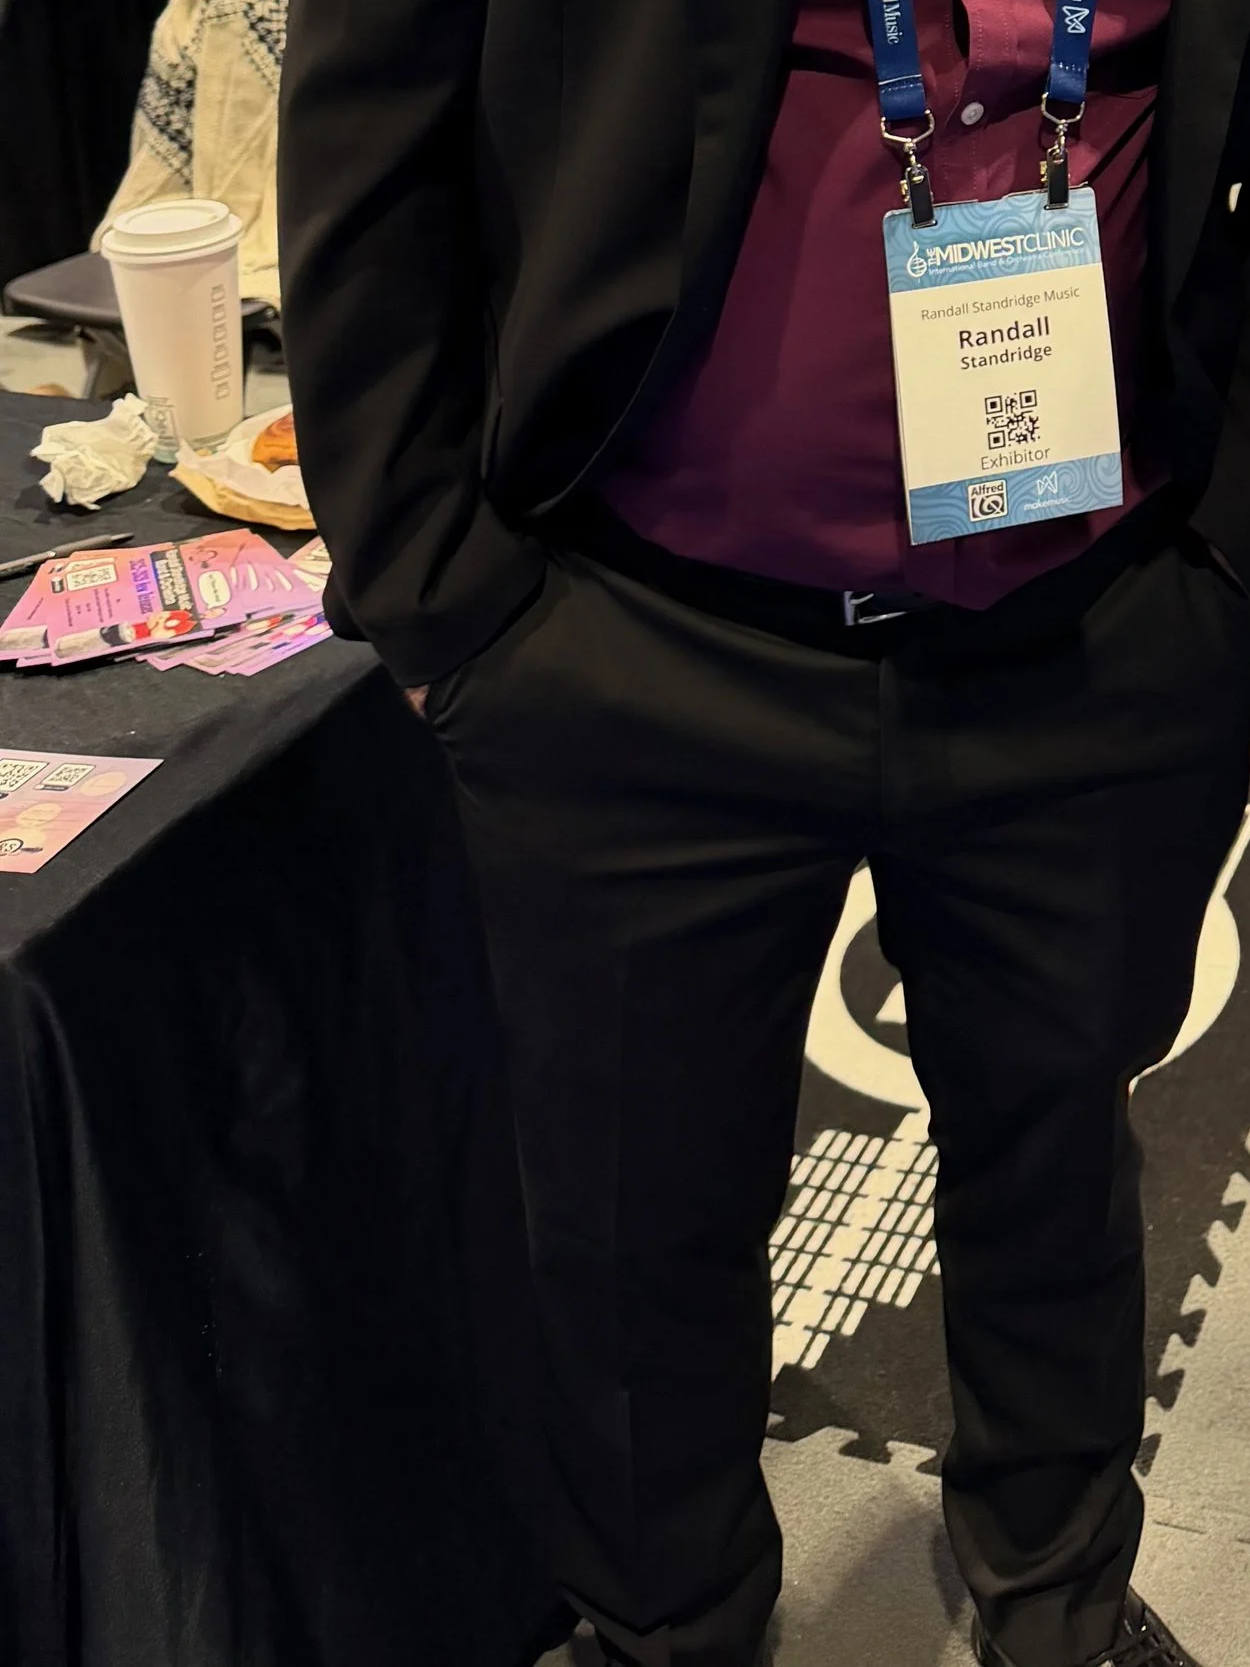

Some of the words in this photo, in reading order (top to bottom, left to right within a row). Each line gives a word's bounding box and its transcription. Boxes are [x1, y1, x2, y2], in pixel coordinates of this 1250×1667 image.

[921, 303, 969, 321] Randall
[972, 293, 1041, 314] Standridge
[1044, 286, 1080, 302] Music
[959, 316, 1050, 349] Randall
[961, 345, 1052, 370] Standridge
[981, 448, 1050, 471] Exhibitor
[971, 482, 1004, 497] Alfred
